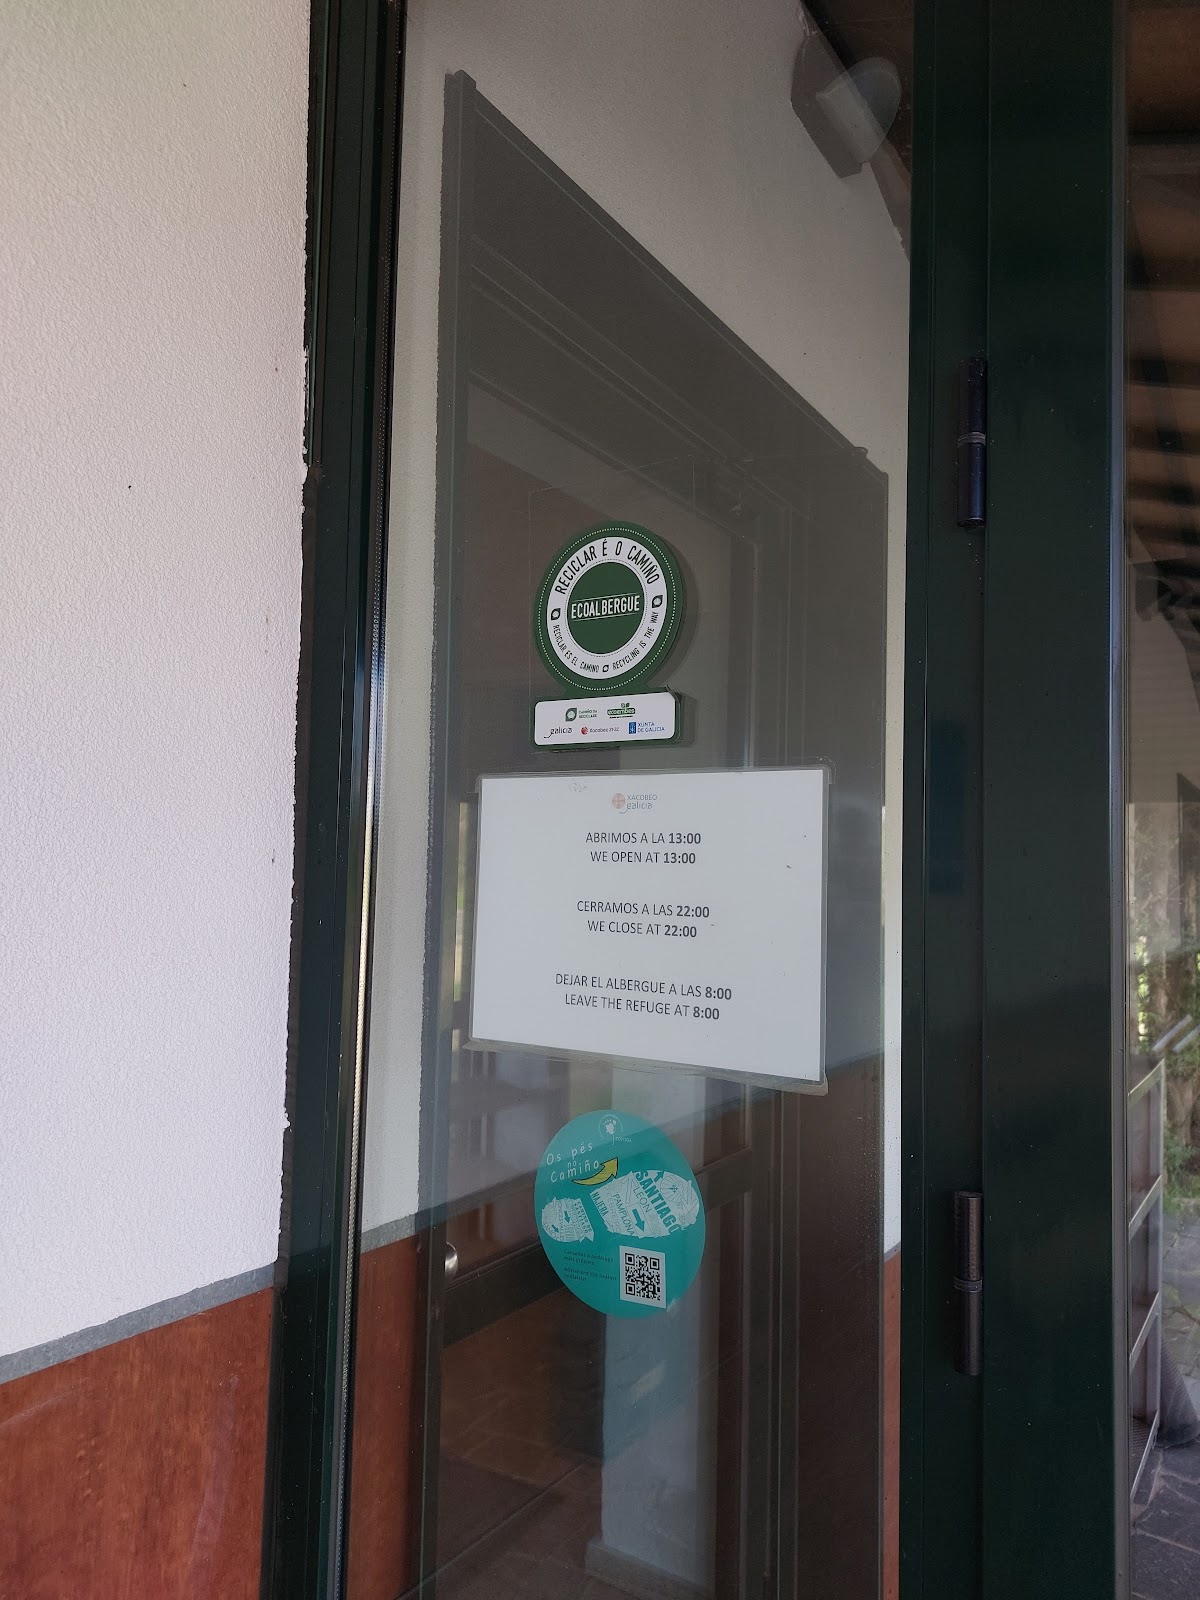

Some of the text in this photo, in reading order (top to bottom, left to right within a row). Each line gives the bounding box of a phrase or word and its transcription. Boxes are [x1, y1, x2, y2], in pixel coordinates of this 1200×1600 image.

[554, 538, 660, 595] RECICLAR É O CAMIÑO
[571, 595, 641, 619] ECOALBERGUE
[553, 624, 567, 653] RECICLAR
[564, 650, 573, 660] ES
[571, 656, 578, 666] EL
[612, 611, 659, 670] RECYCLING IS THE WAY
[544, 726, 573, 738] galicia
[619, 801, 653, 814] galicia
[586, 832, 701, 844] ABRIMOS A LA 13:00
[590, 851, 696, 864] WE OPEN AT 13:00
[577, 901, 710, 918] CERRAMOS A LAS 22:00
[588, 920, 697, 937] WE CLOSE AT 22:00
[555, 973, 732, 1000] DEJAR EL ALBERGUE A LAS 8:00
[565, 994, 720, 1020] LEAVE THE REFUGE AT 8:00
[546, 1142, 593, 1166] Os pés
[568, 1160, 577, 1168] no
[550, 1159, 600, 1183] Camiño
[633, 1186, 652, 1213] LEON
[635, 1170, 682, 1234] SANTIAGO
[612, 1194, 636, 1236] PAMPLONA
